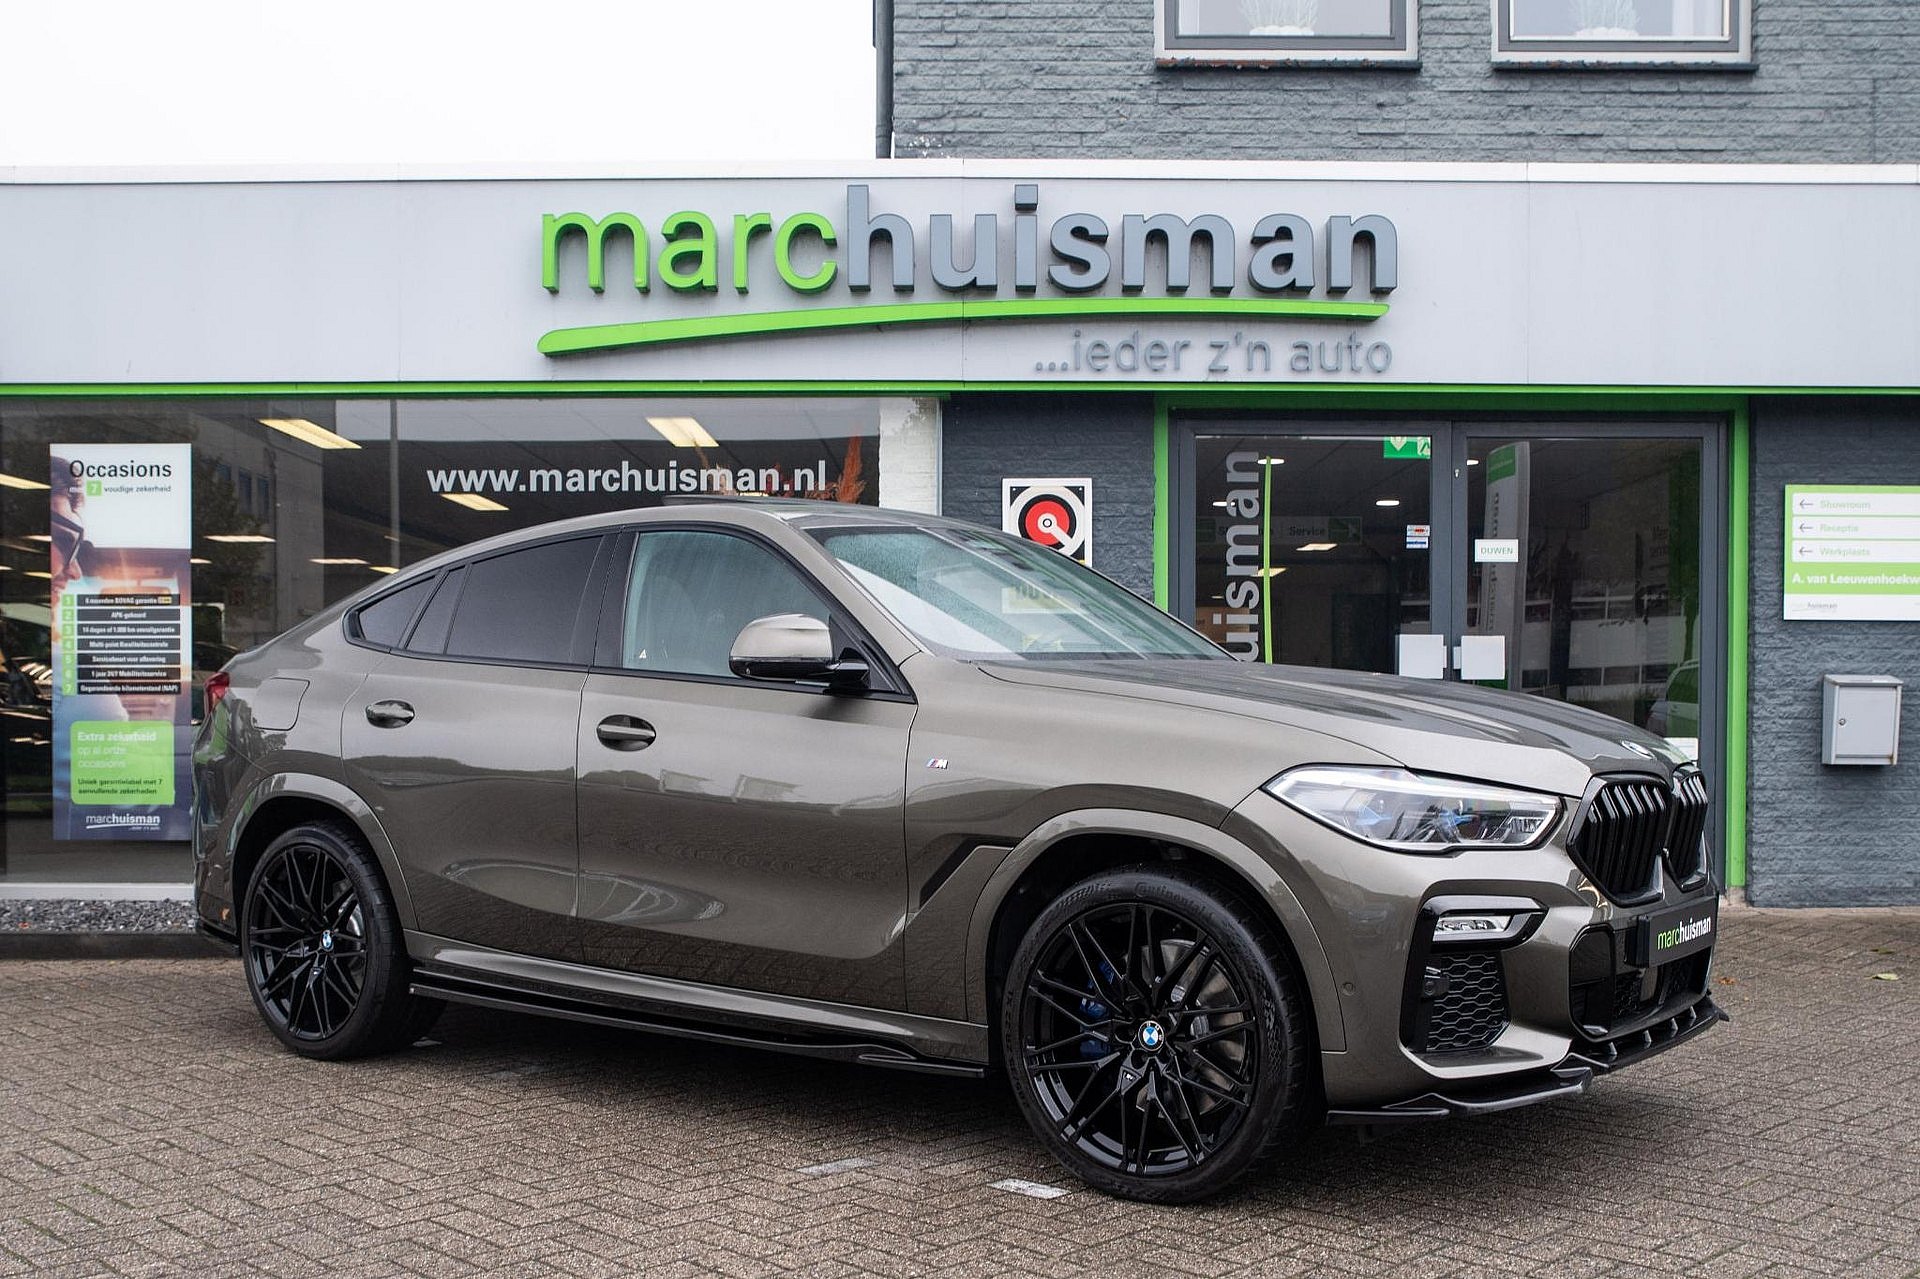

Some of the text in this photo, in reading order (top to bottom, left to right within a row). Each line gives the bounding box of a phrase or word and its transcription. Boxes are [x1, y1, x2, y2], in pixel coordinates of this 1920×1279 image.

[542, 184, 1397, 294] marchuisman
[1208, 332, 1271, 371] z'n
[1290, 332, 1392, 372] auto
[69, 459, 172, 478] Occasions
[426, 460, 826, 492] www.marchuisman.nl
[1820, 500, 1871, 509] Showroom
[1820, 523, 1859, 533] Receptie
[1820, 547, 1870, 557] Werkplaats
[1792, 573, 1804, 584] A.
[1807, 575, 1827, 584] van
[77, 731, 157, 741] Extra zekerheid
[85, 813, 160, 824] marchuisman
[1657, 916, 1711, 950] marchuisman
